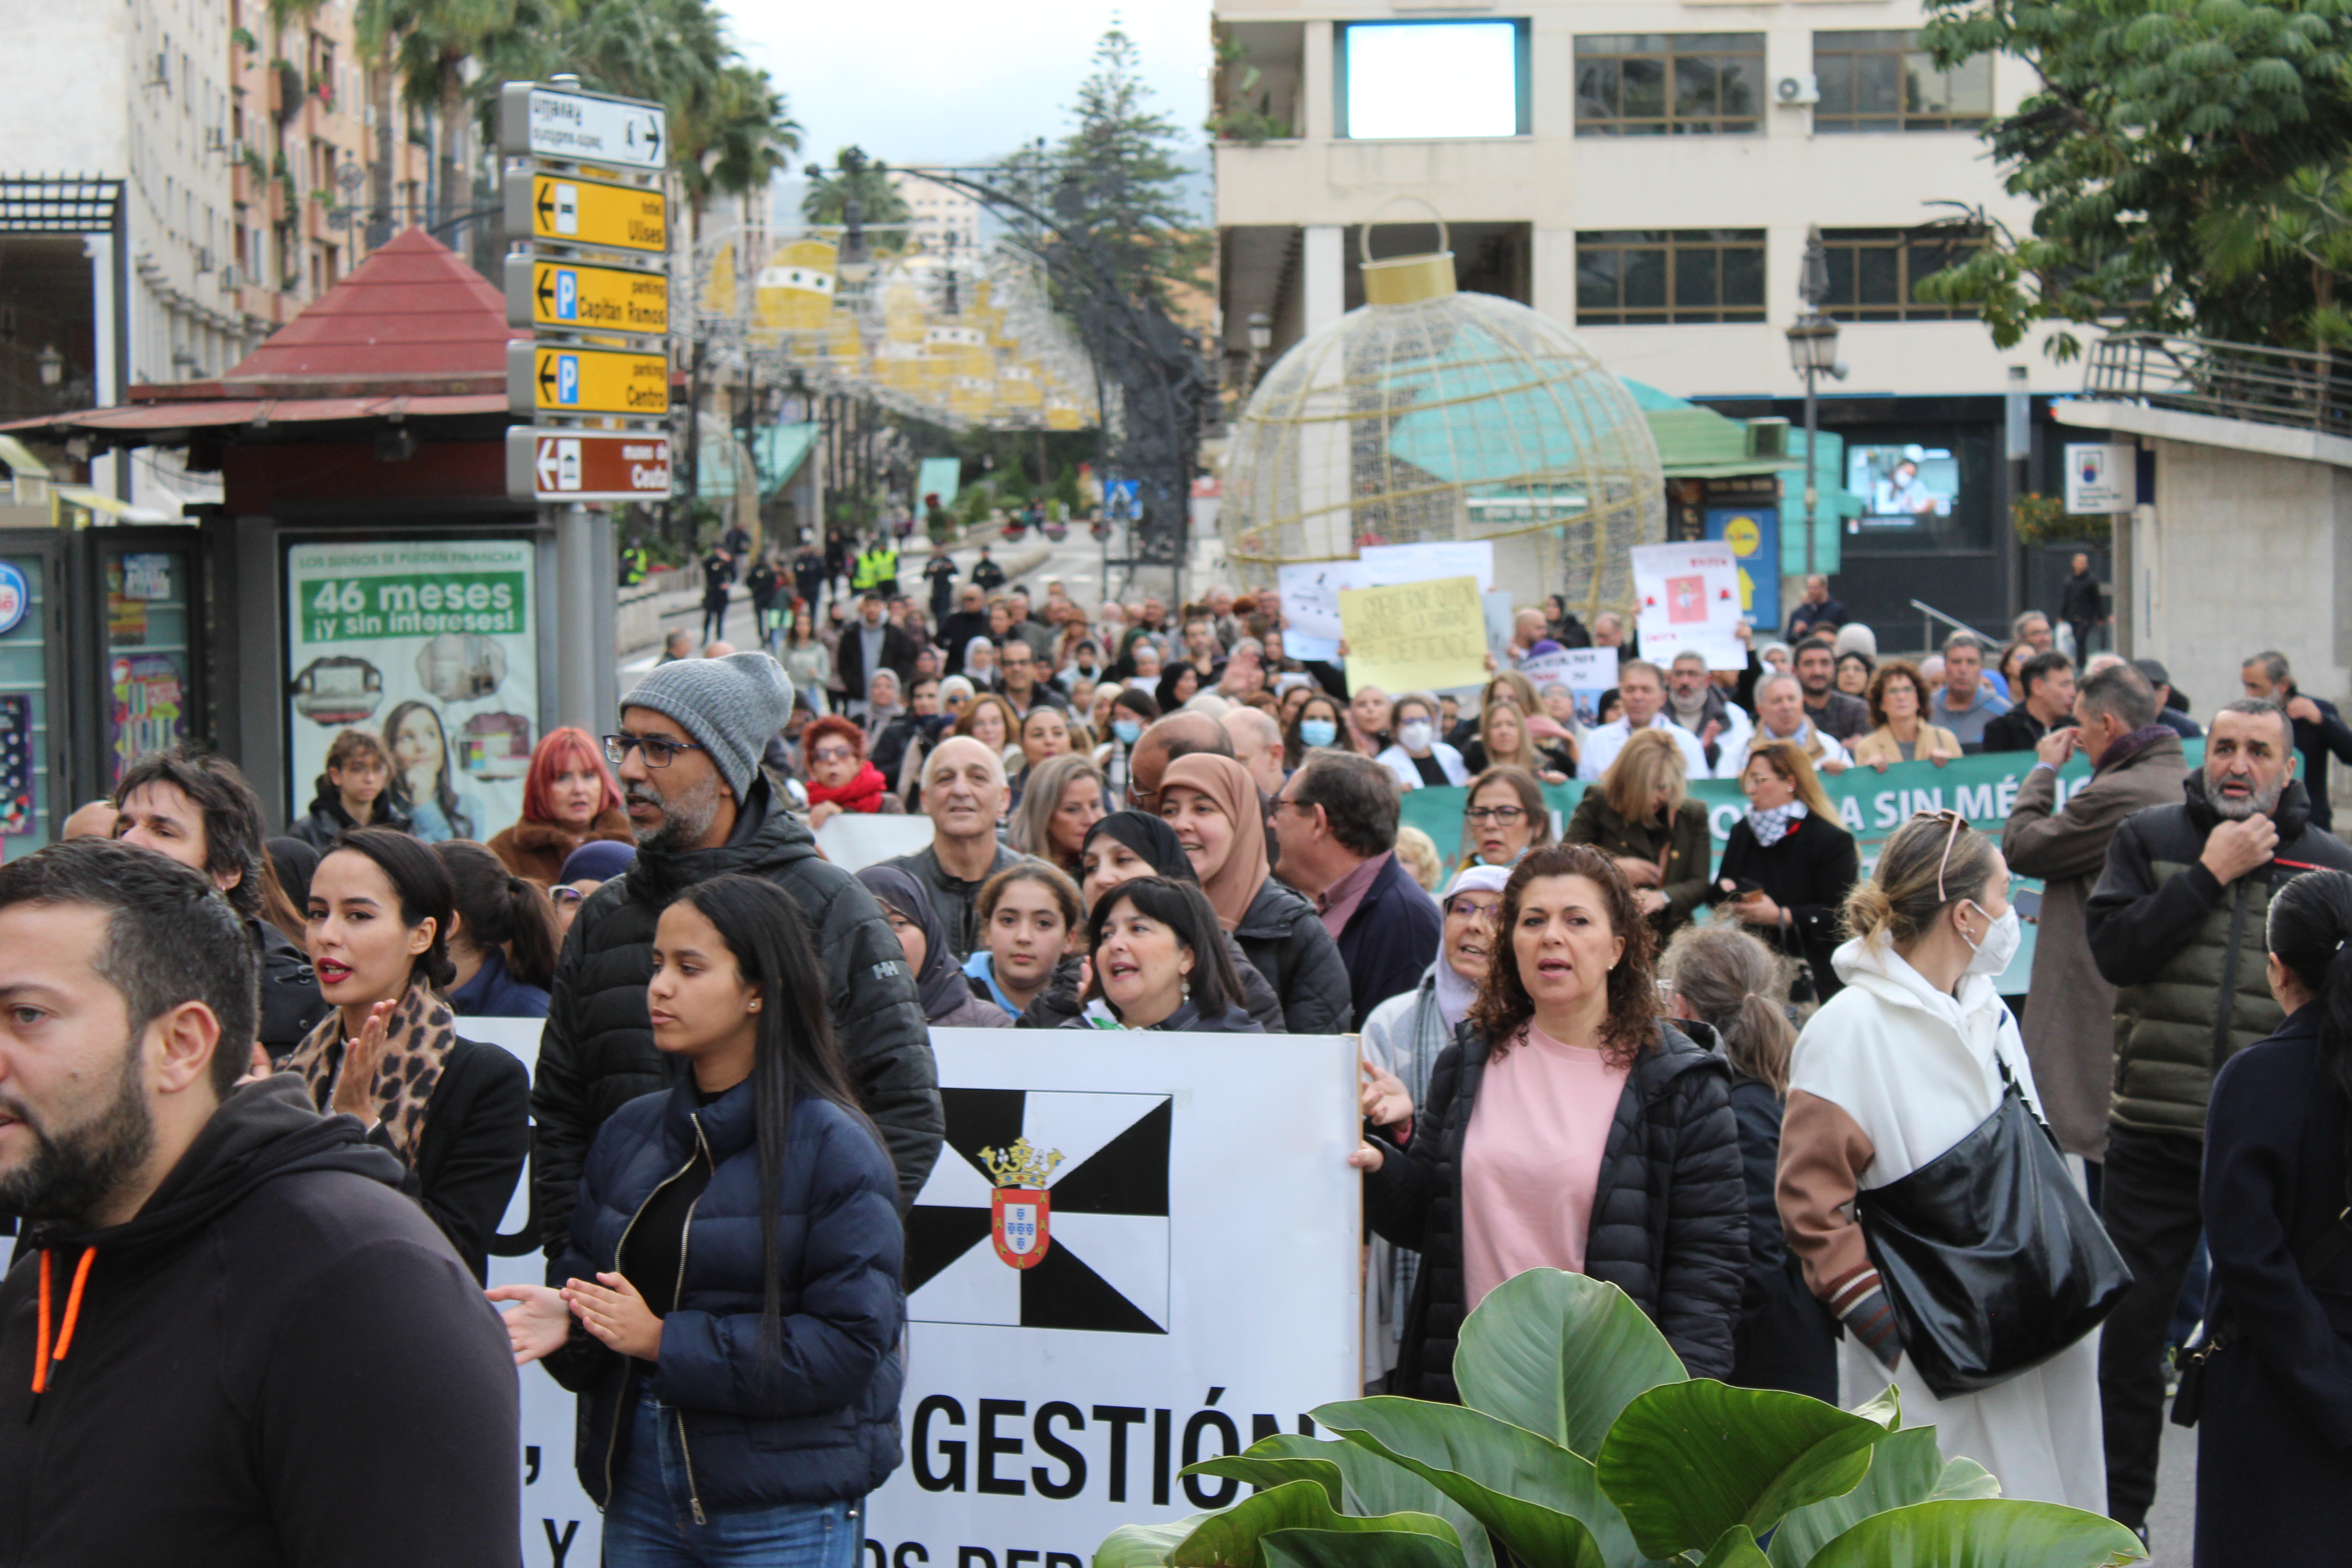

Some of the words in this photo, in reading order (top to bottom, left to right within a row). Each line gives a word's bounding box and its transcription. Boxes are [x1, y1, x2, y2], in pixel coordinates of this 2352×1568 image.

[628, 220, 662, 244] Ulises
[632, 279, 665, 299] parking
[628, 301, 665, 324] Ramos
[627, 385, 664, 407] Centro
[631, 463, 669, 490] Ceuta
[300, 555, 325, 568] LOS
[399, 551, 449, 564] PUEDEN
[452, 550, 523, 563] FINANCIAR
[314, 581, 366, 614] 46
[378, 582, 513, 612] meses
[344, 609, 382, 634] sin
[389, 608, 514, 632] intereses!
[1873, 786, 1944, 830] SIN
[871, 960, 900, 980] HH
[911, 1386, 1315, 1510] GESTIÓ
